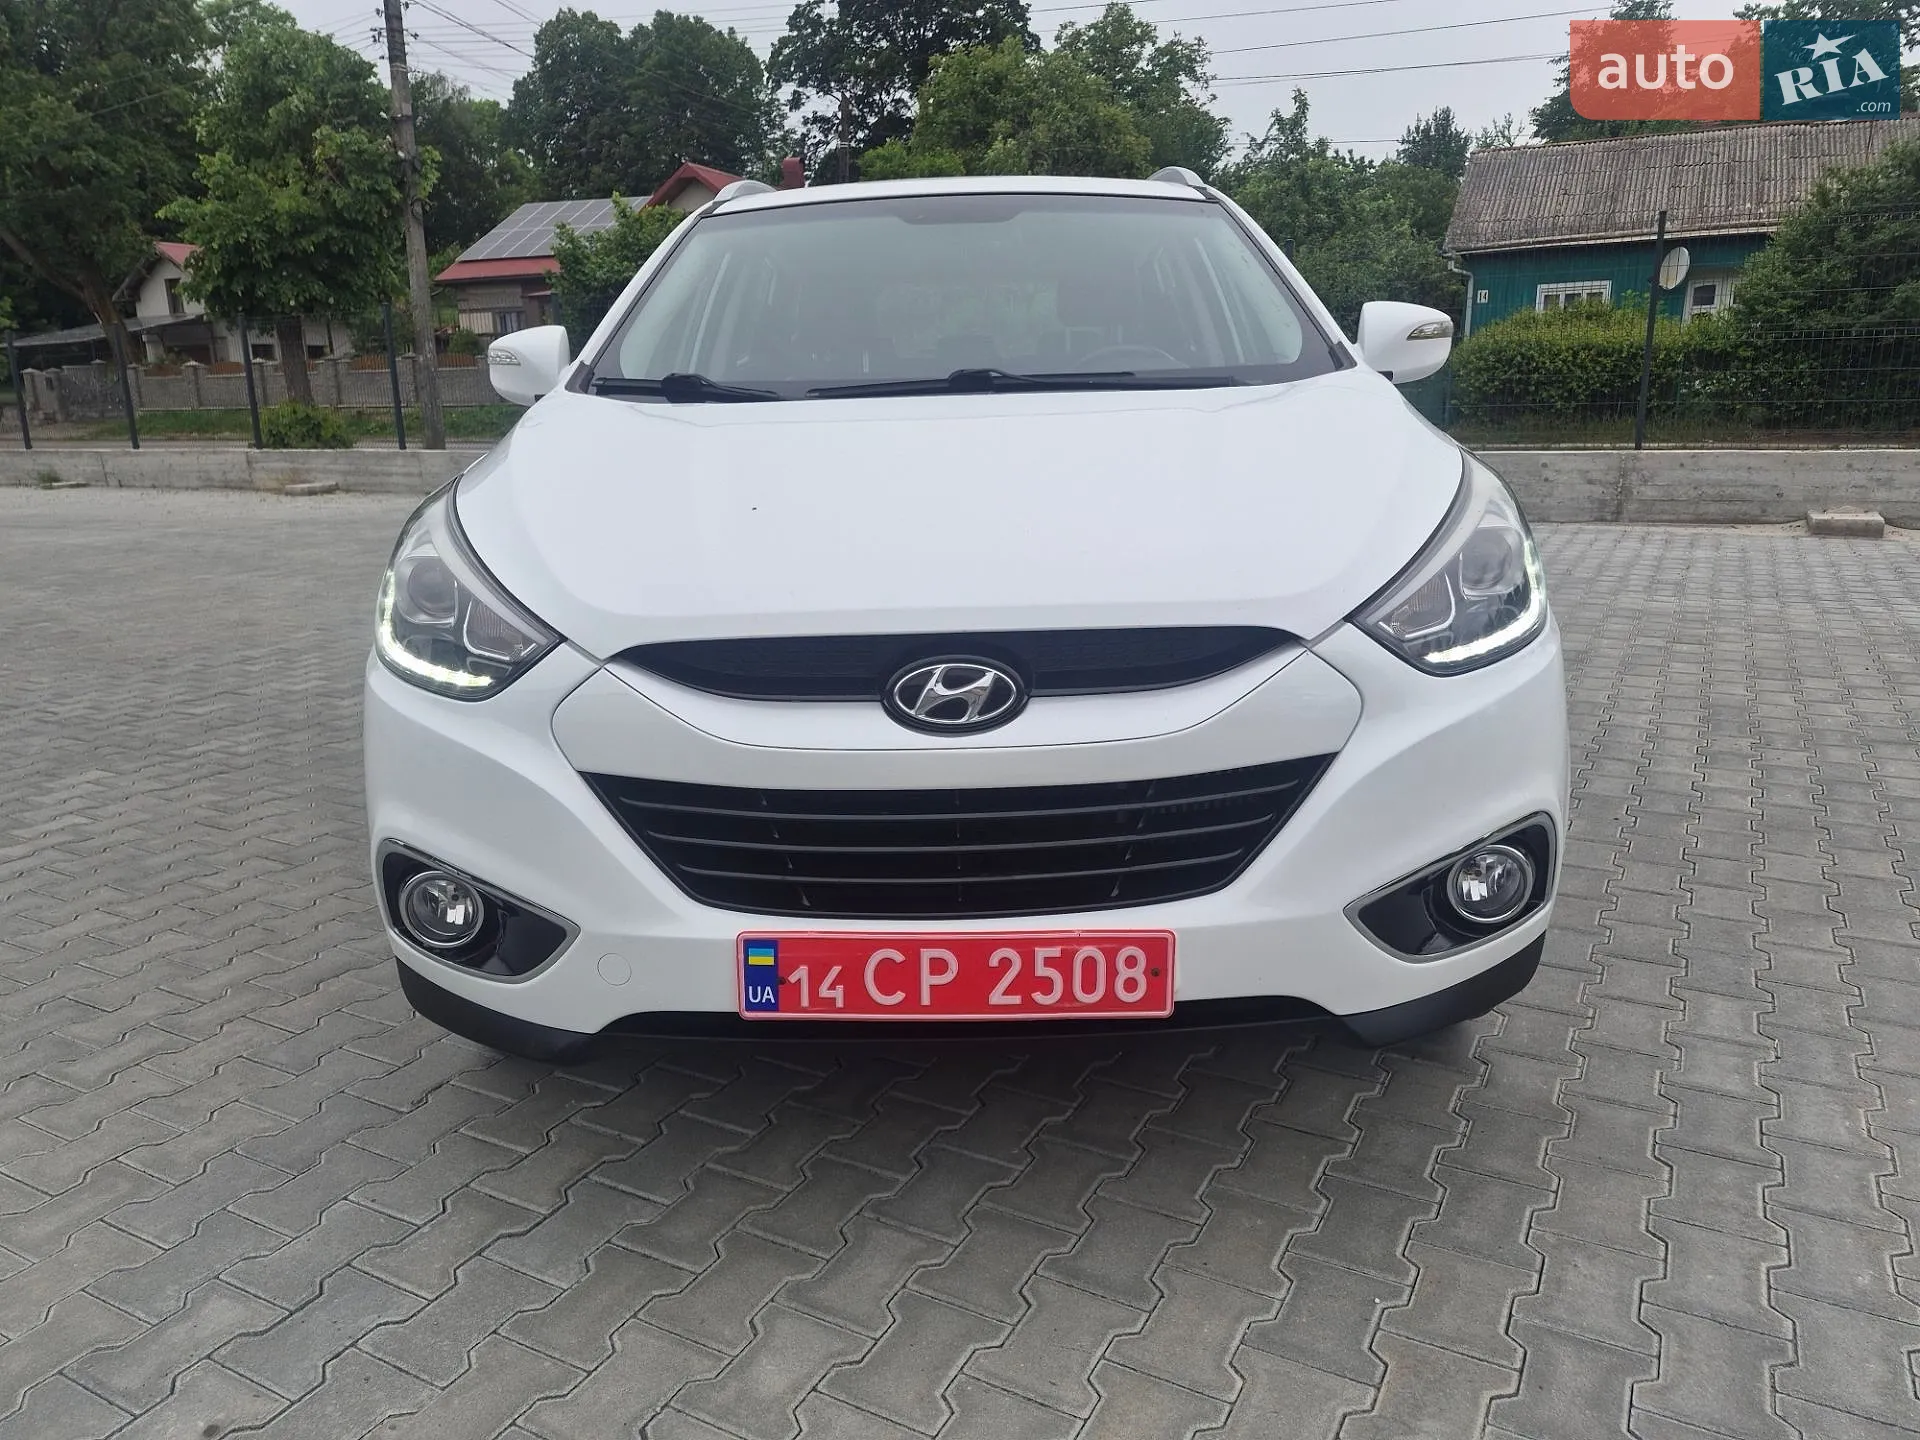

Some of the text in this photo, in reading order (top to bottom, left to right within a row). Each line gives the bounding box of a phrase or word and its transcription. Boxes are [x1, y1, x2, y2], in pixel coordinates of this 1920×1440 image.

[748, 986, 775, 1003] UA
[787, 946, 1148, 1009] 14 CP 2508
